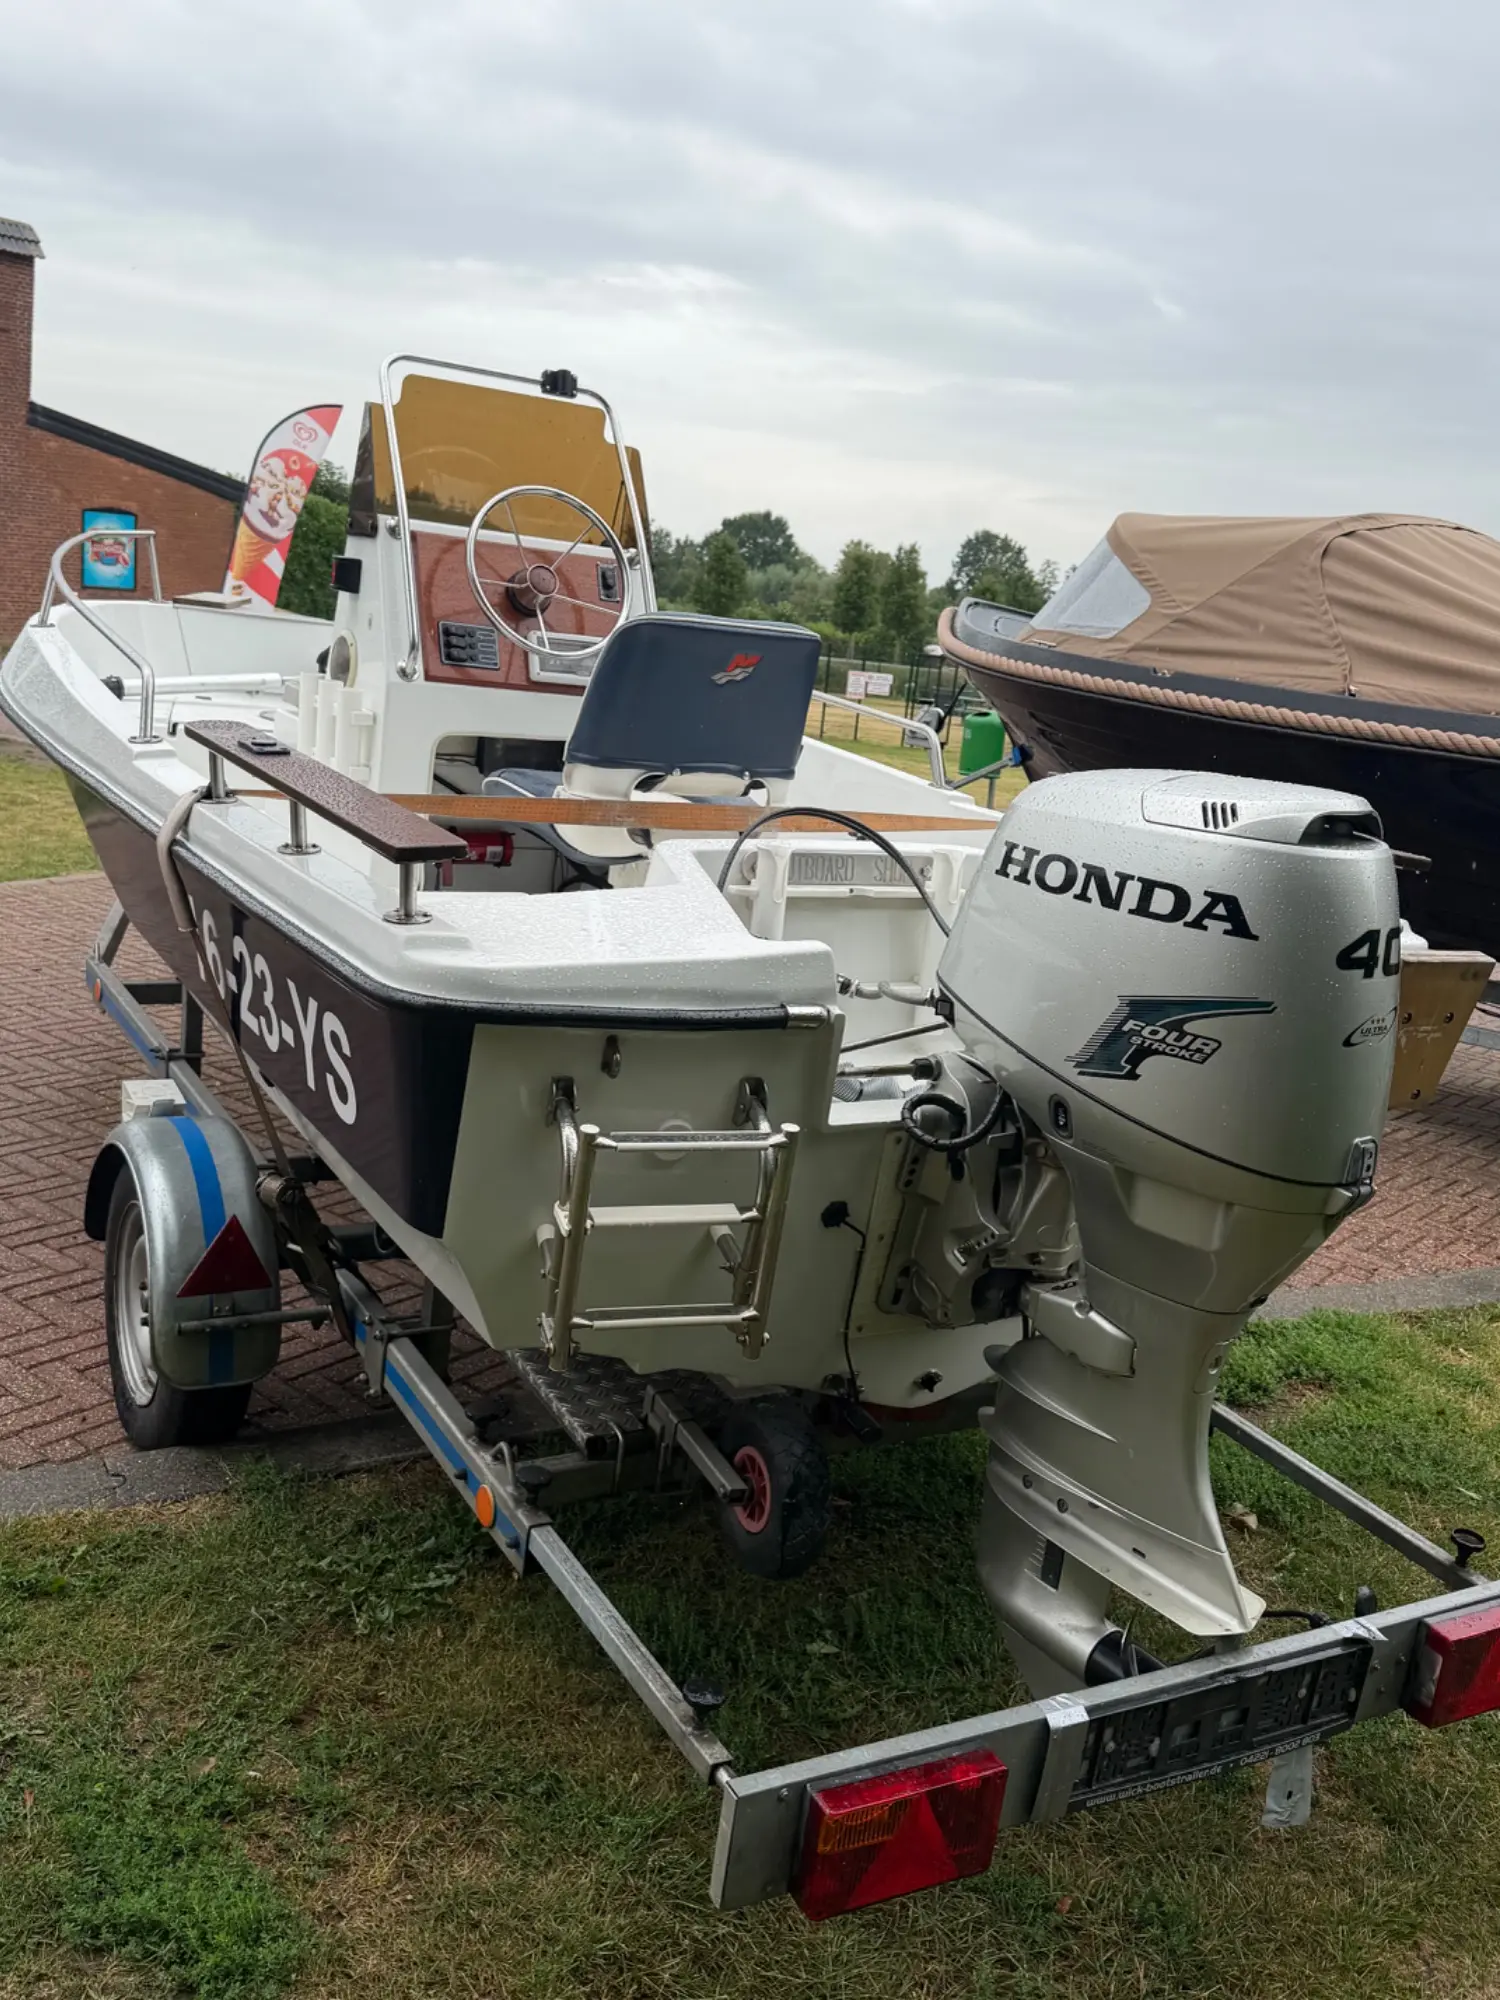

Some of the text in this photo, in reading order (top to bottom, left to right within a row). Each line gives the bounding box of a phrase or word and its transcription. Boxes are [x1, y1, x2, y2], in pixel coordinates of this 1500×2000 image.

[994, 840, 1260, 941] HONDA
[1335, 926, 1403, 979] 40
[1121, 1018, 1220, 1055] FOUR
[1128, 1035, 1207, 1063] STROKE
